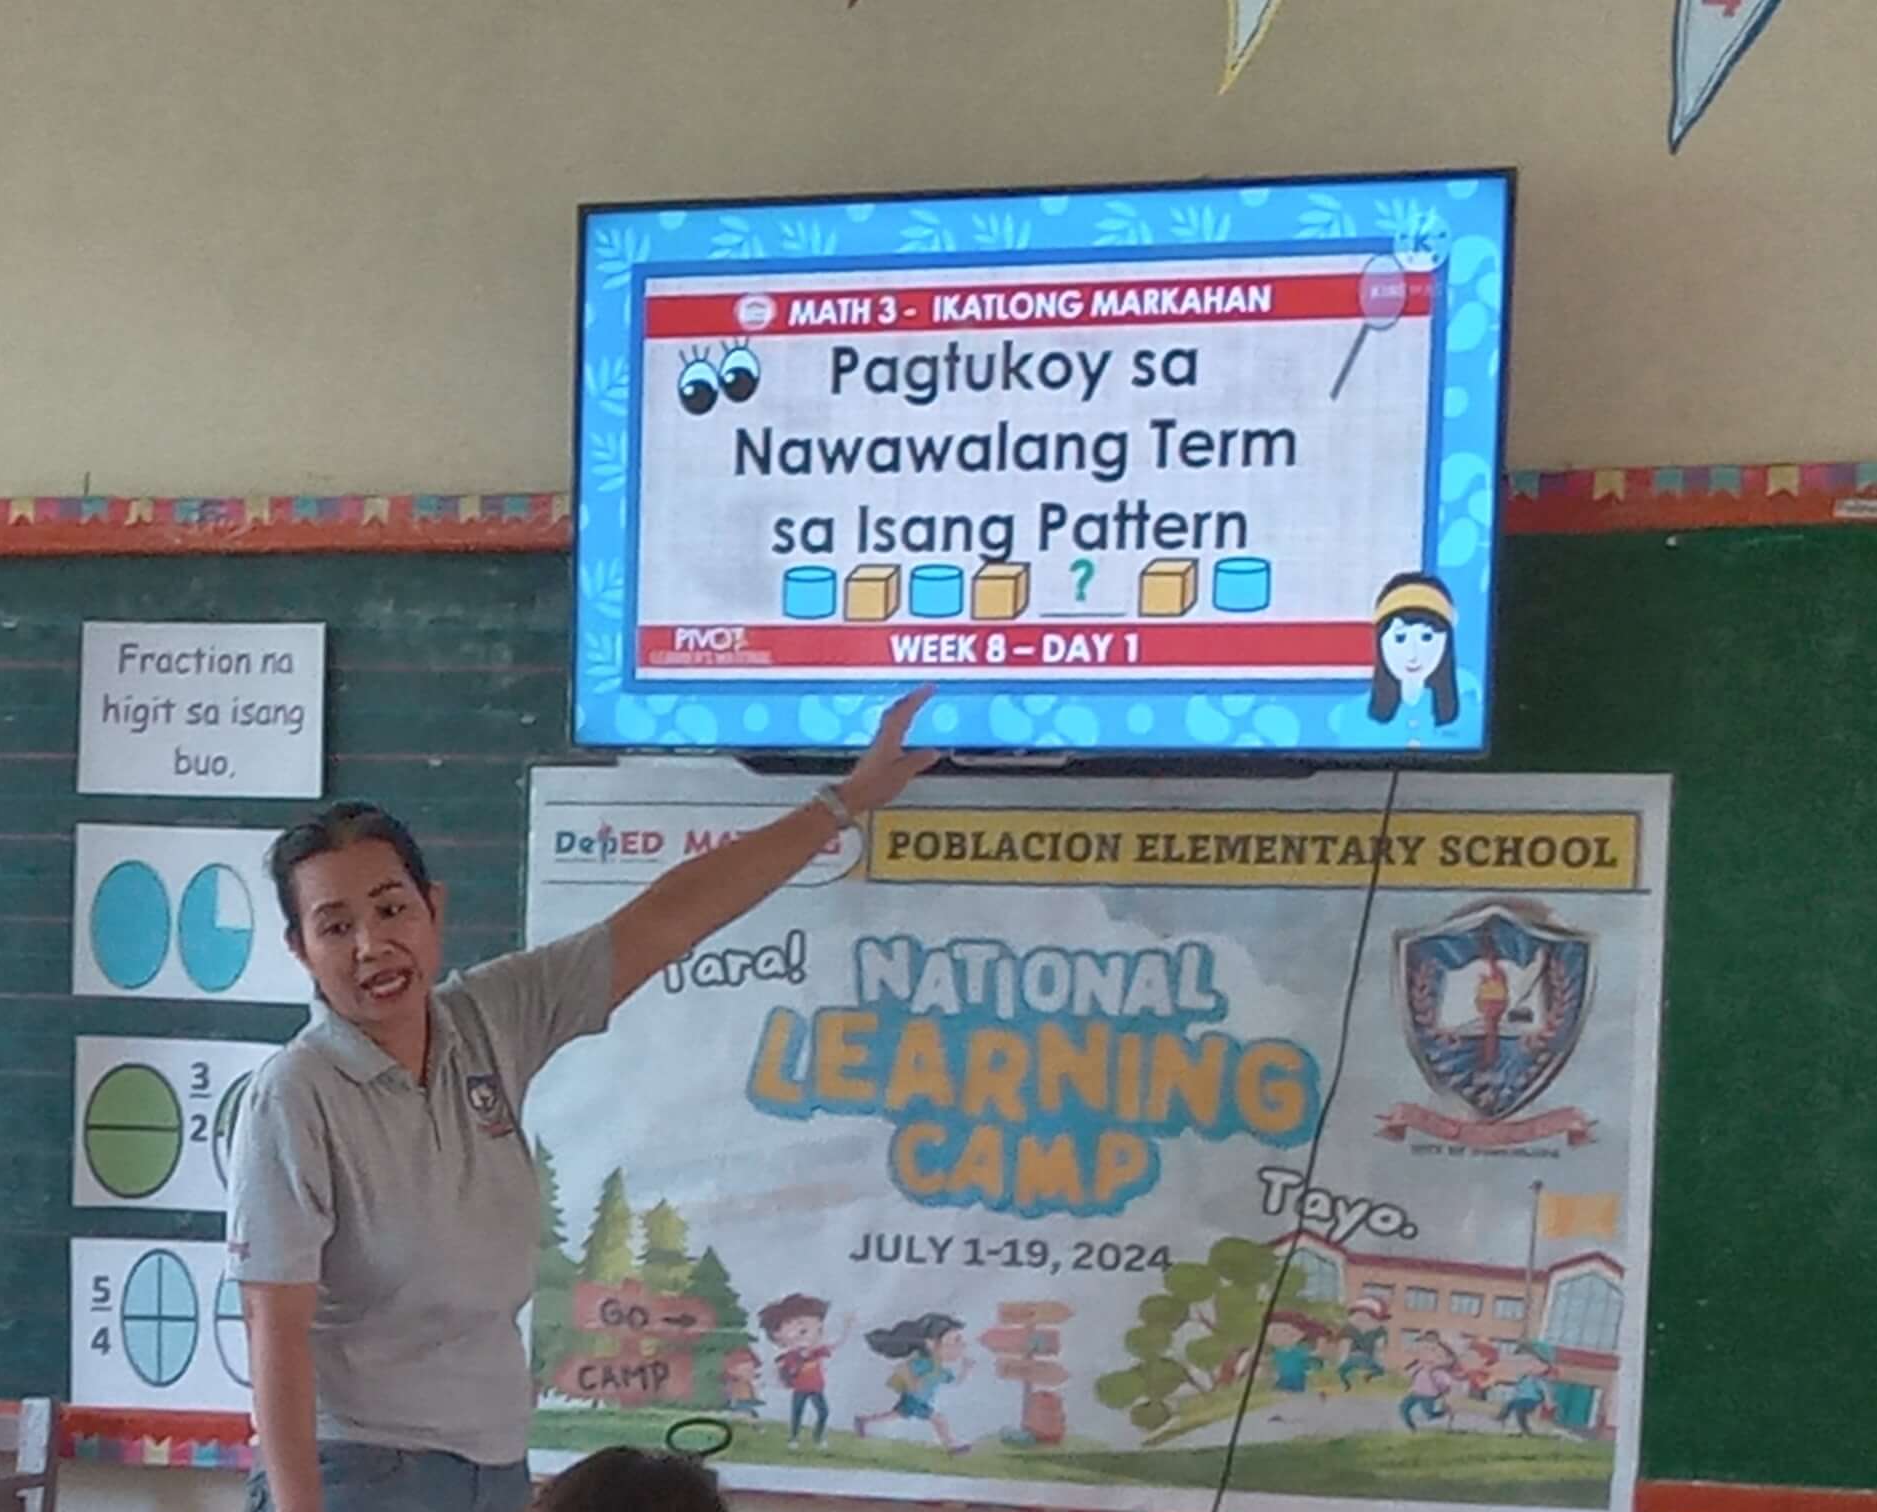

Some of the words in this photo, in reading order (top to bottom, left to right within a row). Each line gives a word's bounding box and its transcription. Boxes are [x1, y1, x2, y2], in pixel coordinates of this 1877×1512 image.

[788, 298, 871, 326] MATH
[879, 297, 898, 323] 3
[932, 289, 1083, 322] IKATLONG
[1090, 285, 1272, 319] MARKAHAN
[830, 340, 1114, 406] Pagtukoy
[1130, 347, 1198, 388] sa
[735, 421, 1128, 483] Nawawalang
[1150, 419, 1298, 469] Term
[772, 515, 834, 554] sa
[858, 505, 1014, 562] Isang
[1039, 499, 1248, 552] Pattern
[1070, 559, 1096, 602] ?
[118, 642, 251, 675] Fraction
[261, 651, 293, 673] na
[891, 634, 977, 663] WEEK
[986, 633, 1006, 662] 8
[1042, 633, 1114, 662] DAY
[1125, 633, 1140, 661] 1
[102, 694, 175, 734] higit
[186, 702, 219, 725] sa
[231, 697, 305, 734] isang
[887, 831, 1122, 866] POBLACION
[1136, 833, 1425, 867] ELEMENTARY
[1439, 835, 1618, 868] SCHOOL
[858, 935, 1225, 1020] NATIONAL
[190, 1061, 211, 1091] 3
[751, 1007, 1312, 1138] LEARNING
[190, 1114, 208, 1142] 2
[893, 1122, 1152, 1205] CAMP
[1258, 1166, 1418, 1241] Tayo.
[850, 1233, 952, 1265] JULY
[964, 1238, 1061, 1274] 1-19,
[1073, 1241, 1172, 1271] 2024
[92, 1276, 111, 1304] 5
[601, 1298, 649, 1329] GO
[90, 1327, 112, 1356] 4
[578, 1361, 669, 1391] CAMP
